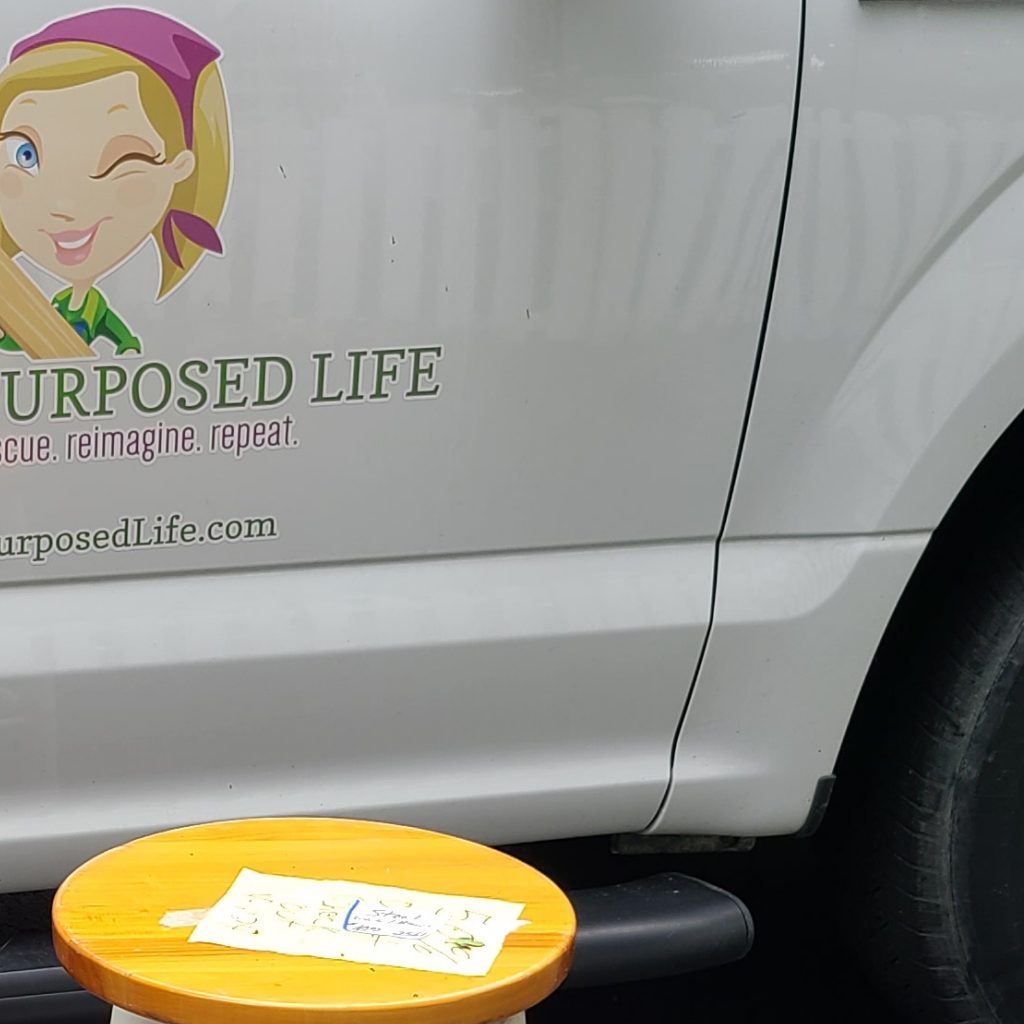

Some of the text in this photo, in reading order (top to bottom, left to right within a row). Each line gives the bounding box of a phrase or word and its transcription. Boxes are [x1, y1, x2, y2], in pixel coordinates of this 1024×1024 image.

[310, 346, 443, 404] LIFE
[66, 421, 202, 463] reimagine.
[210, 415, 299, 457] repeat.
